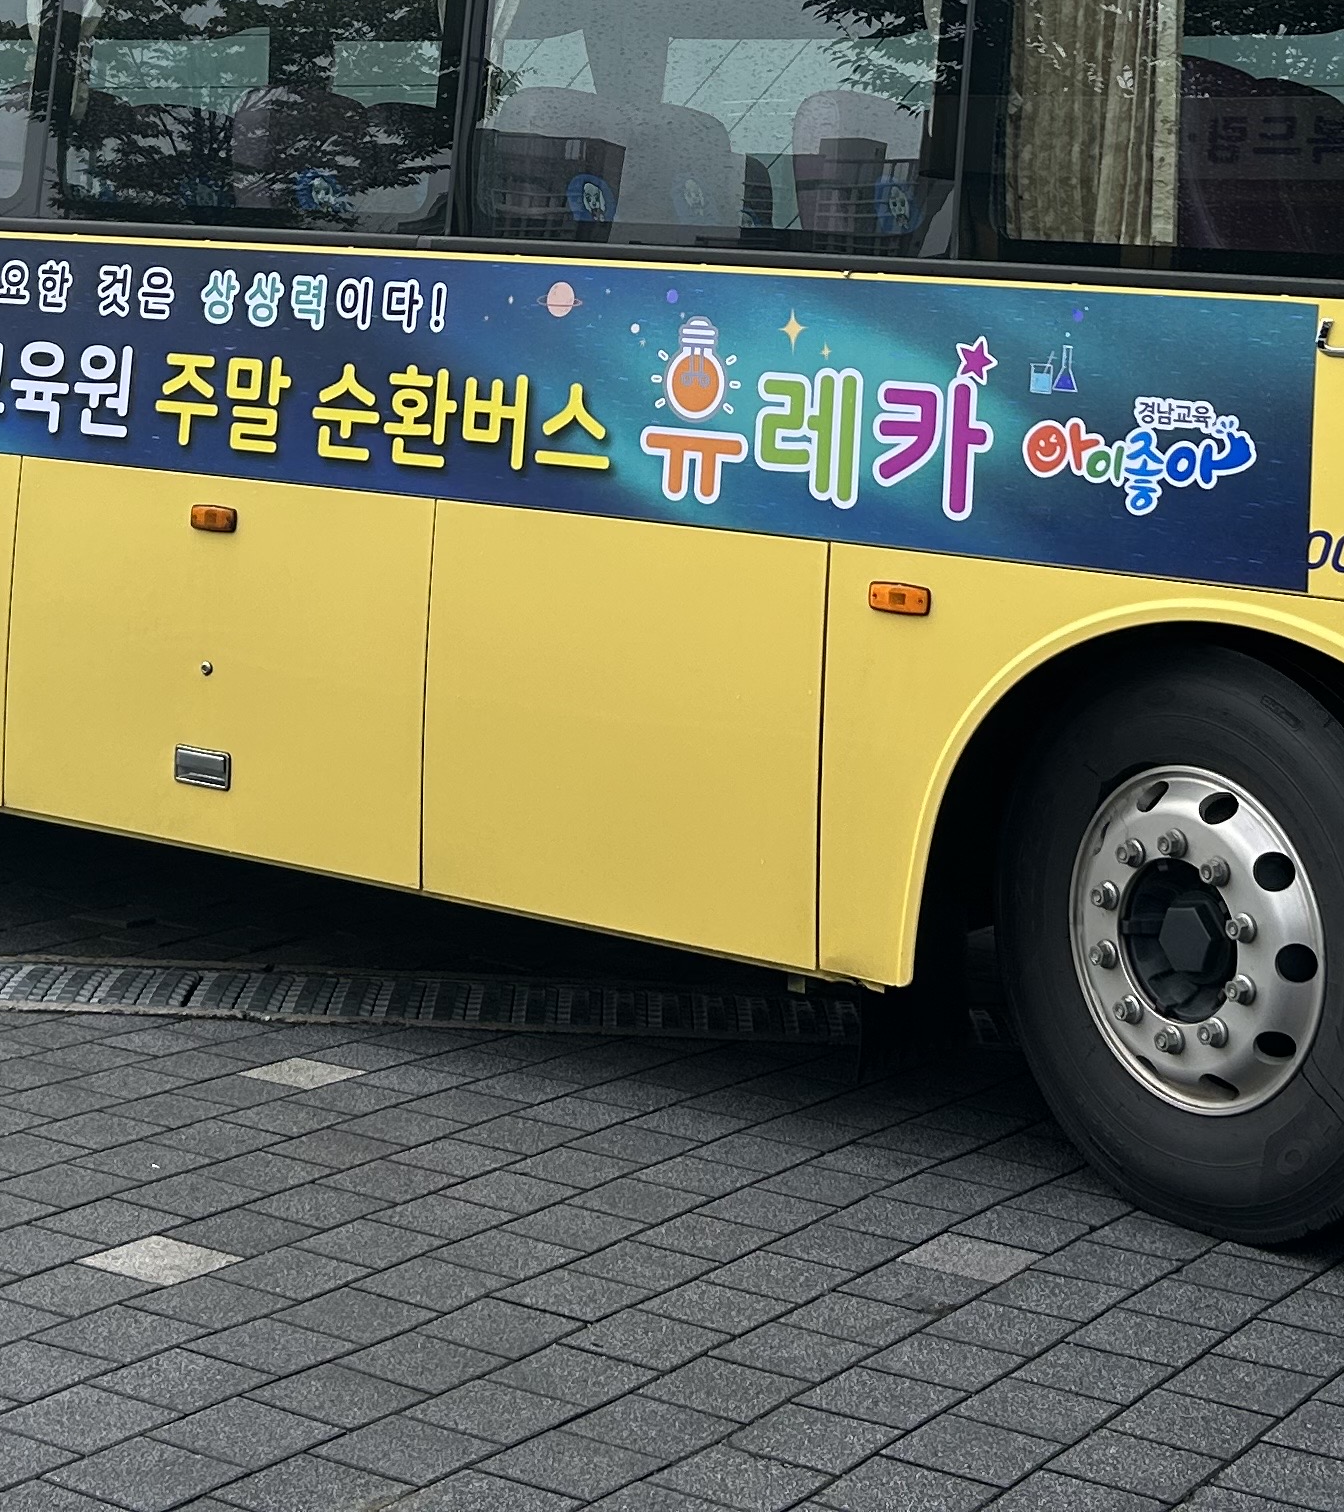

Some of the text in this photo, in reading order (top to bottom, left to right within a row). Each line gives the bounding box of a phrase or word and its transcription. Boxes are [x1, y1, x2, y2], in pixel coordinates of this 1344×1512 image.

[96, 264, 174, 320] 것은
[199, 270, 448, 333] 상상력이다!
[154, 350, 291, 454] 주말
[311, 361, 611, 472] 순환버스
[641, 316, 993, 521] 유레카
[1137, 400, 1212, 426] 경남교육
[1024, 420, 1256, 514] 아이좋아
